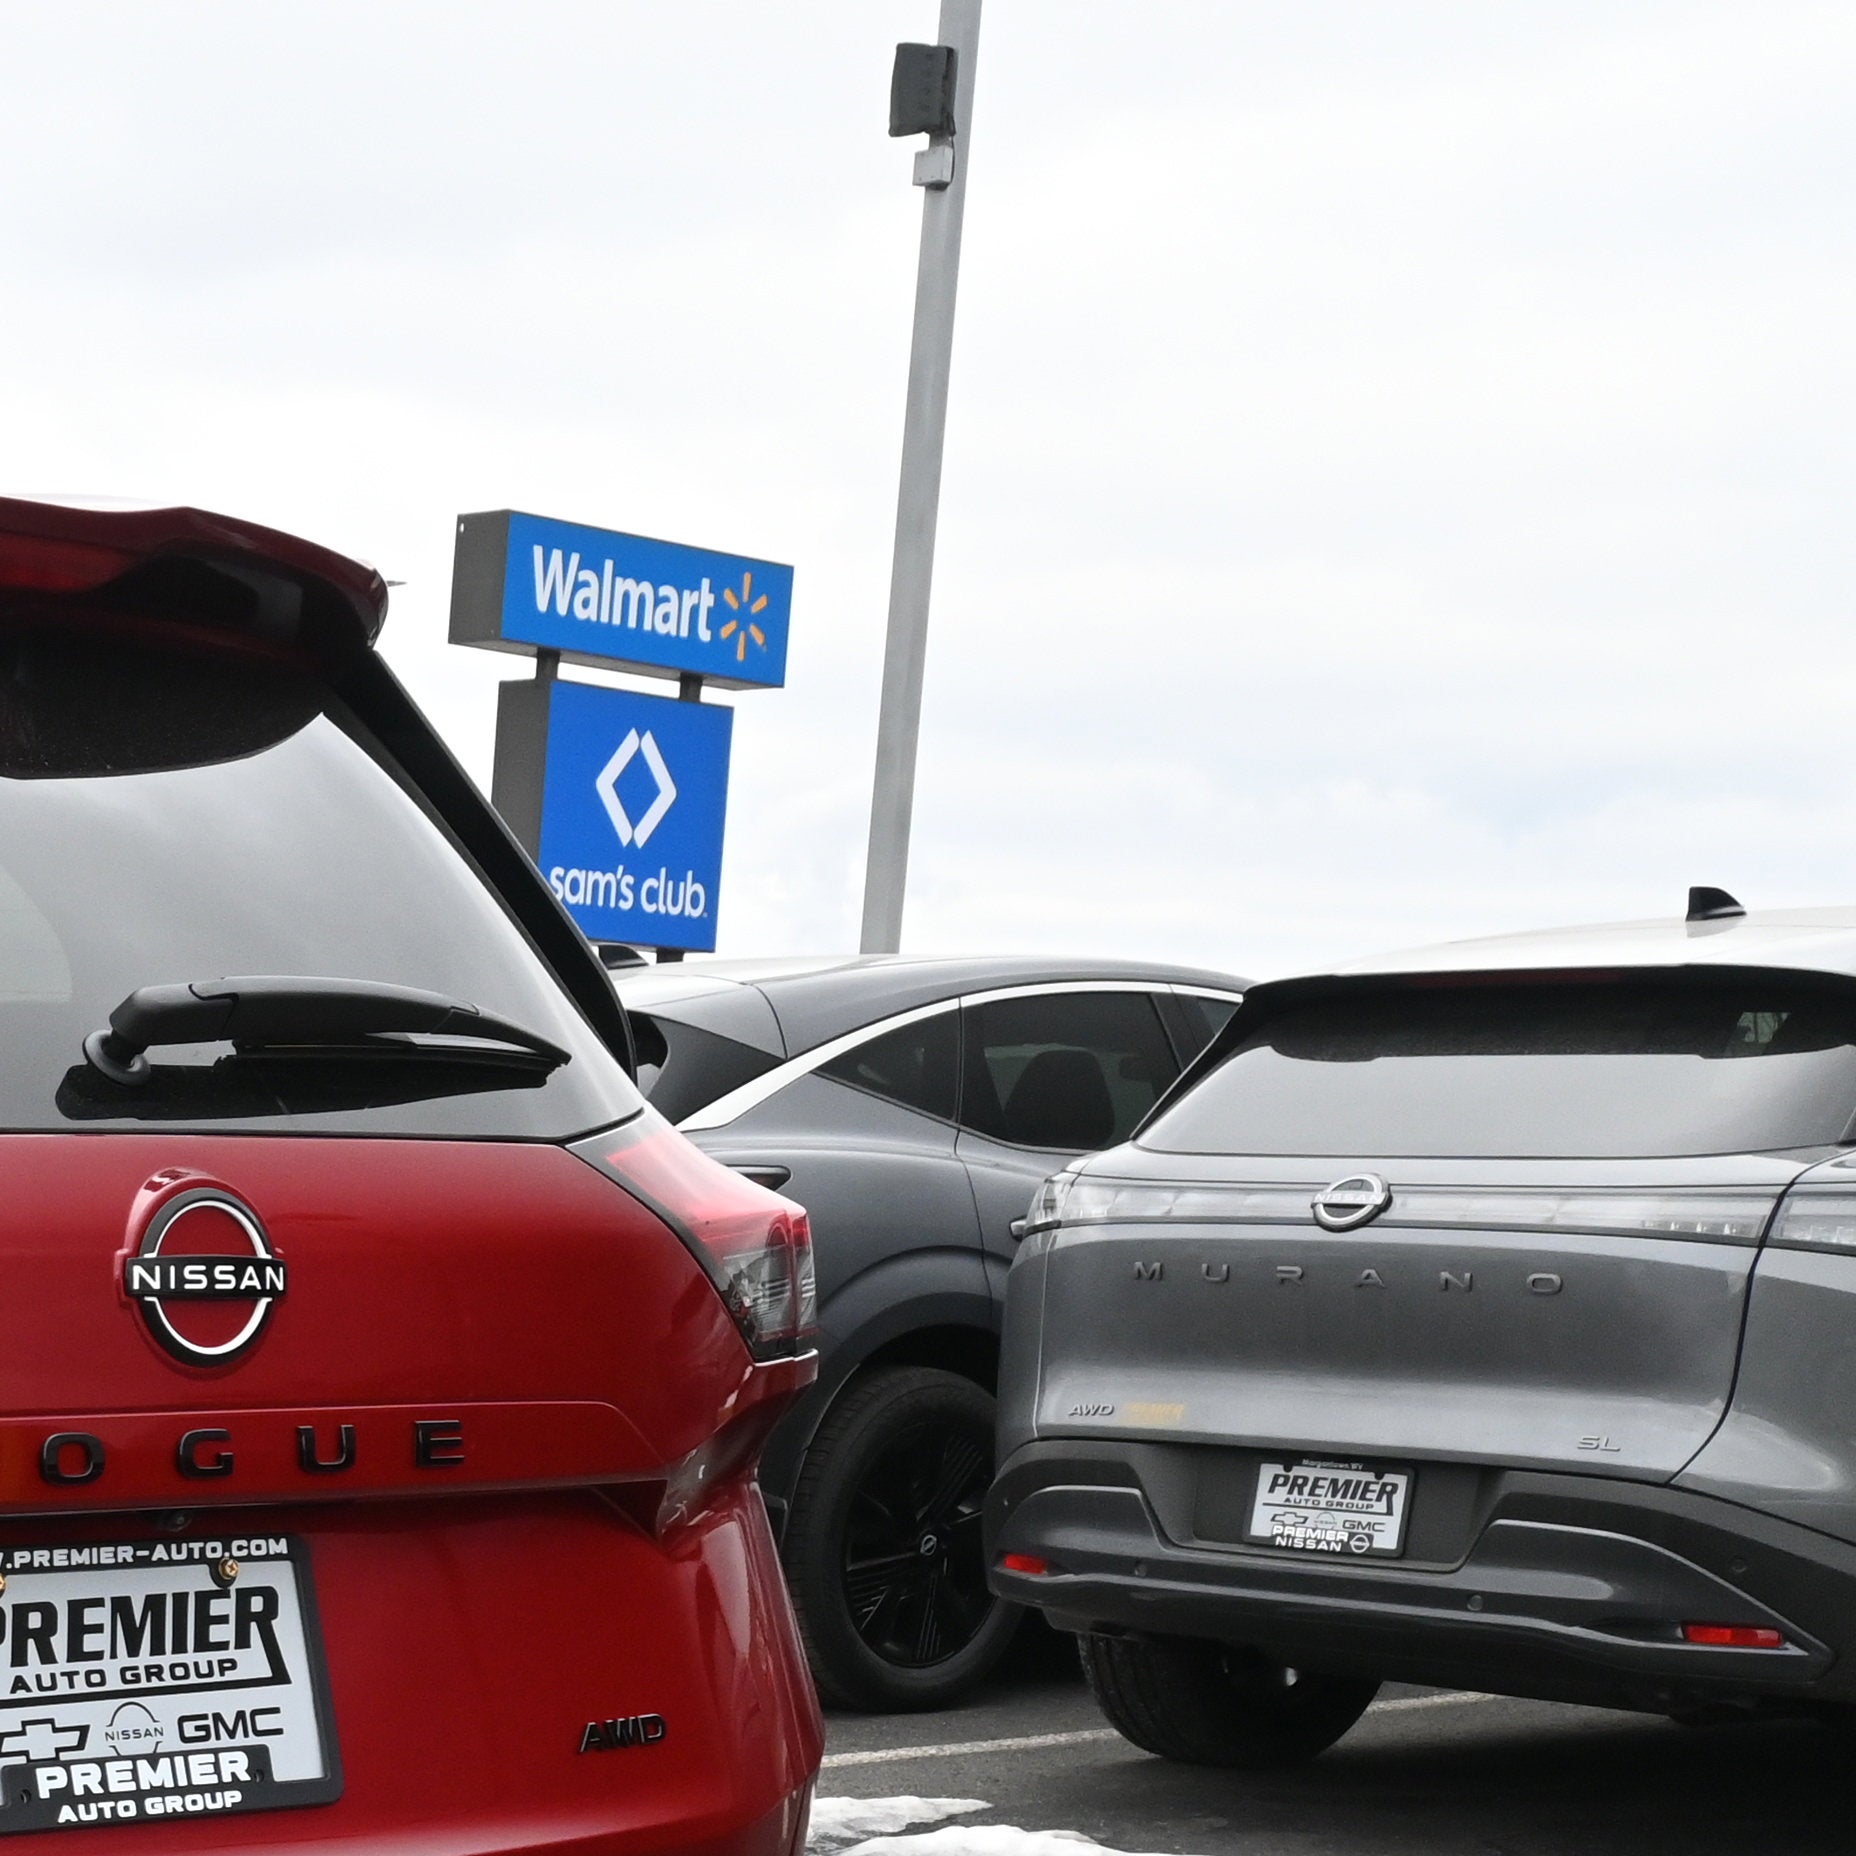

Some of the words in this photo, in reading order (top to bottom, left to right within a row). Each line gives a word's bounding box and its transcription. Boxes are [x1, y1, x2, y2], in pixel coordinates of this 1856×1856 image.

[532, 543, 715, 643] Walmart
[549, 864, 635, 911] sam's
[131, 1264, 286, 1292] NISSAN
[1132, 1260, 1564, 1296] MURANO
[1068, 1403, 1116, 1417] AWD
[1576, 1435, 1622, 1453] SL
[1267, 1473, 1400, 1516] PREMIER
[1283, 1497, 1321, 1506] AUTO
[1325, 1501, 1375, 1510] GROUP
[1272, 1525, 1350, 1543] PREMIER
[1342, 1519, 1387, 1533] GMC
[1275, 1536, 1343, 1553] NISSAN
[8, 1667, 107, 1695] AUTO
[119, 1657, 239, 1686] GROUP
[104, 1725, 165, 1744] NISSAN
[176, 1706, 286, 1745] GMC
[577, 1712, 667, 1754] AWD
[34, 1749, 252, 1800] PREMIER
[56, 1801, 138, 1825] AUTO
[144, 1789, 243, 1816] GROUP
